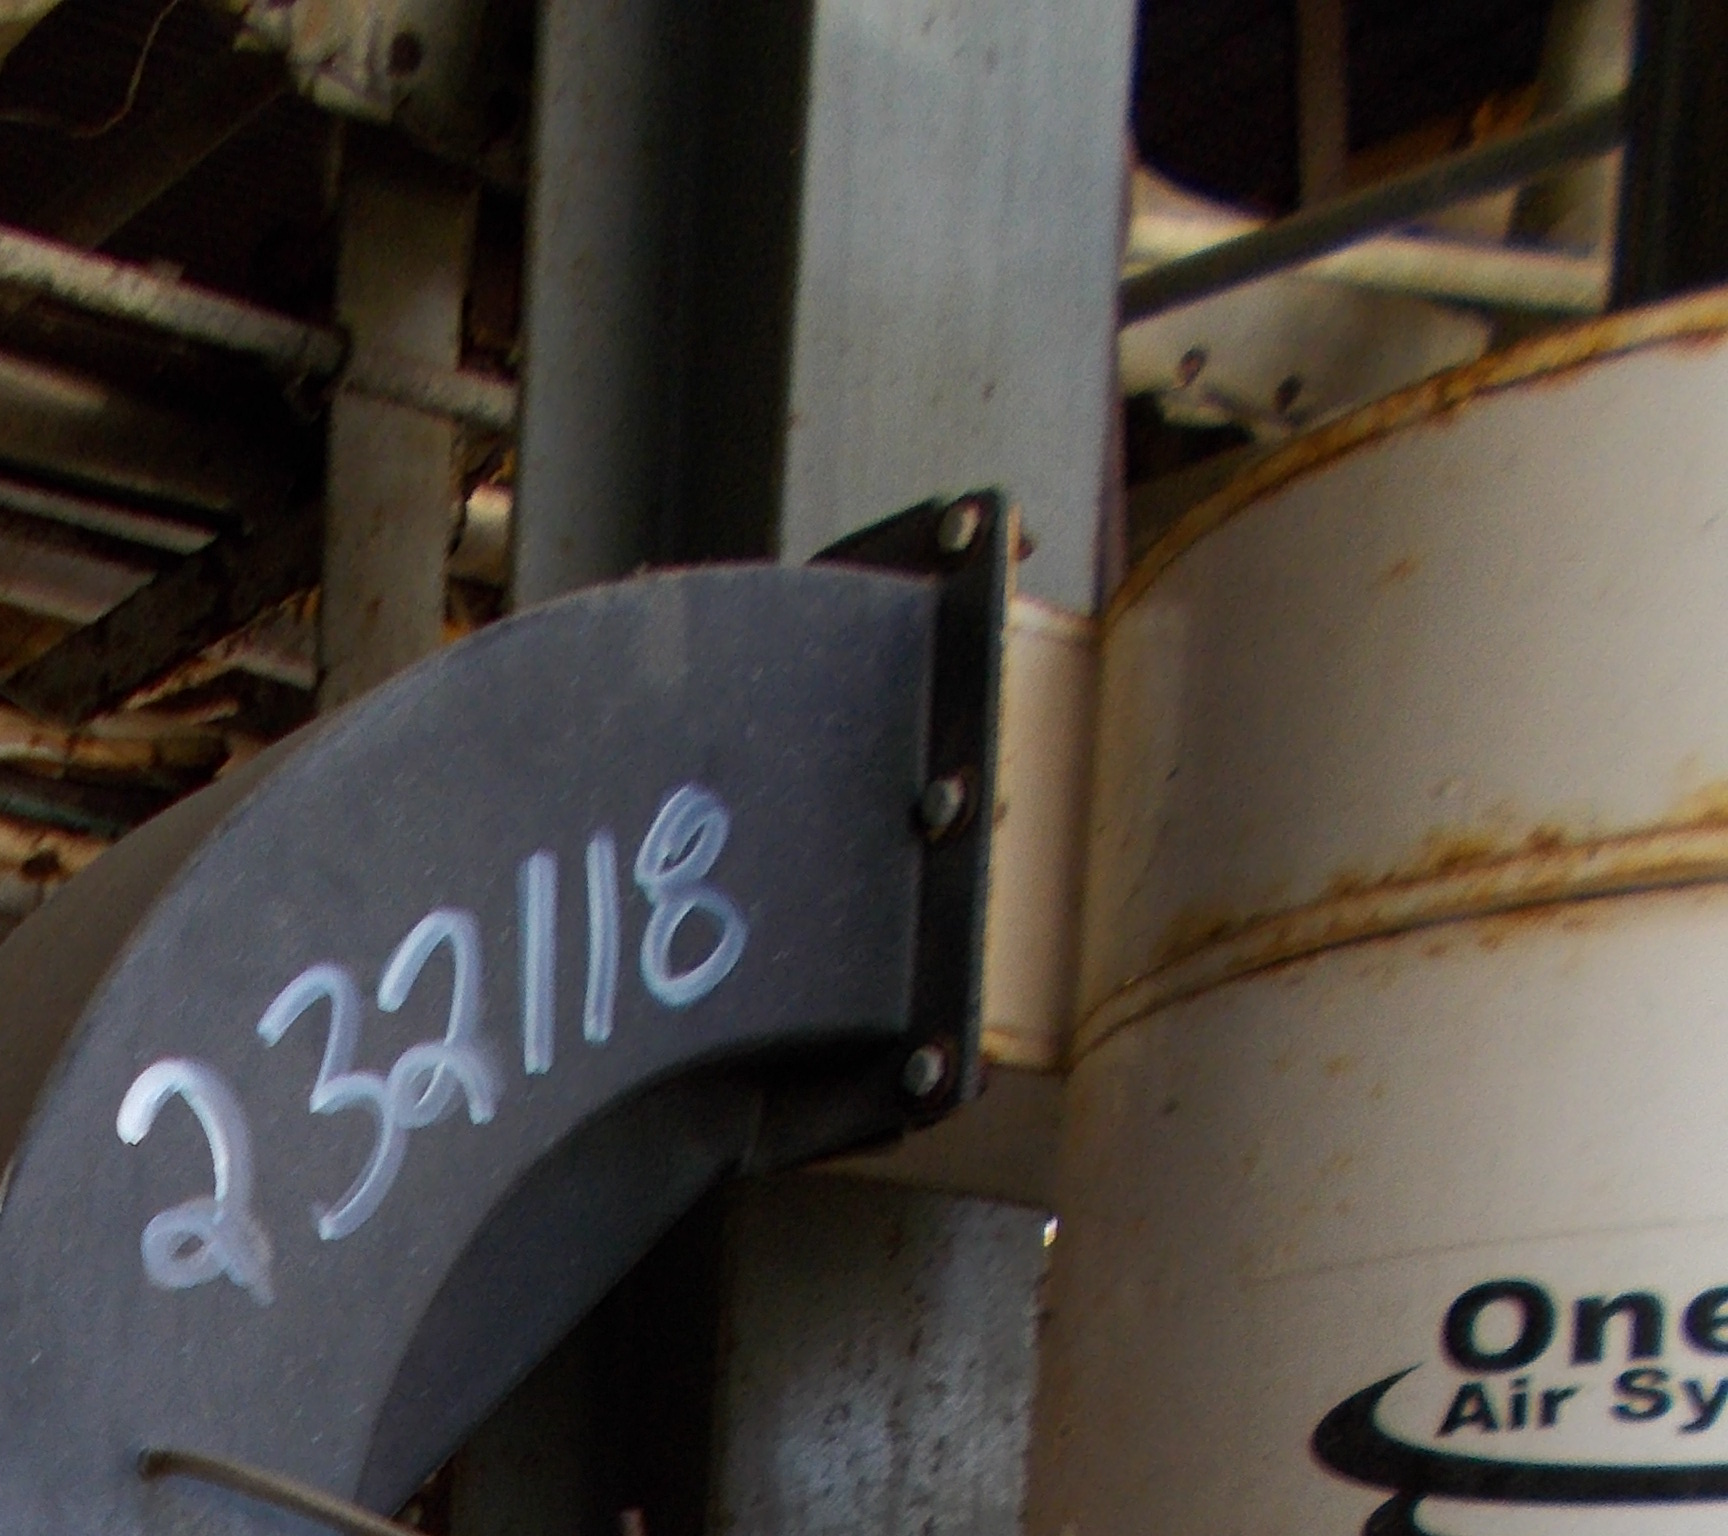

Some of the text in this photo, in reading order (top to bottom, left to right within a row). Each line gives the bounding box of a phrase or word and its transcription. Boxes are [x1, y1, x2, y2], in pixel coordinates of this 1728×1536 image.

[115, 783, 749, 1307] 232118
[1435, 1367, 1728, 1438] Air Sy
